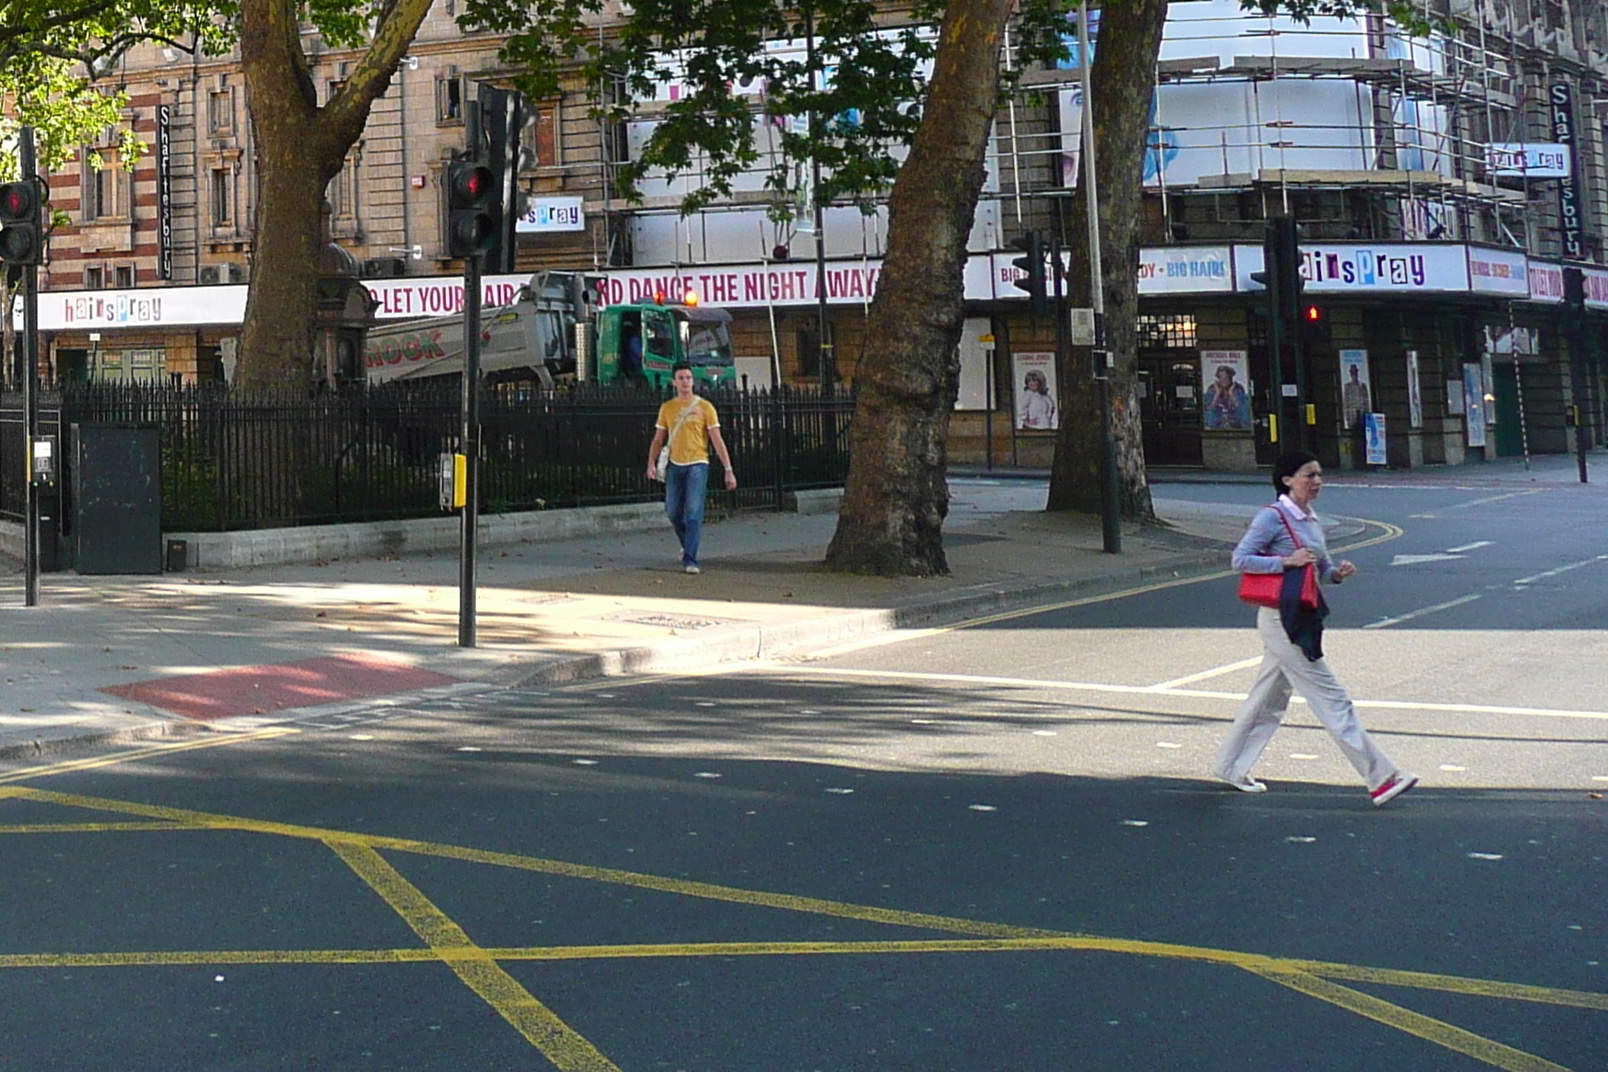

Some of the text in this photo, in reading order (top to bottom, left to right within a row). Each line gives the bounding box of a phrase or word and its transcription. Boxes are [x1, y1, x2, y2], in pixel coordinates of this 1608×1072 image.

[160, 105, 171, 279] Shaftesbury
[1299, 250, 1425, 286] airspray
[64, 294, 162, 323] hairspray
[384, 288, 413, 314] LET
[418, 285, 465, 313] YOUR
[484, 283, 515, 307] AIR
[699, 274, 739, 303] THE
[744, 271, 808, 302] NIGHT
